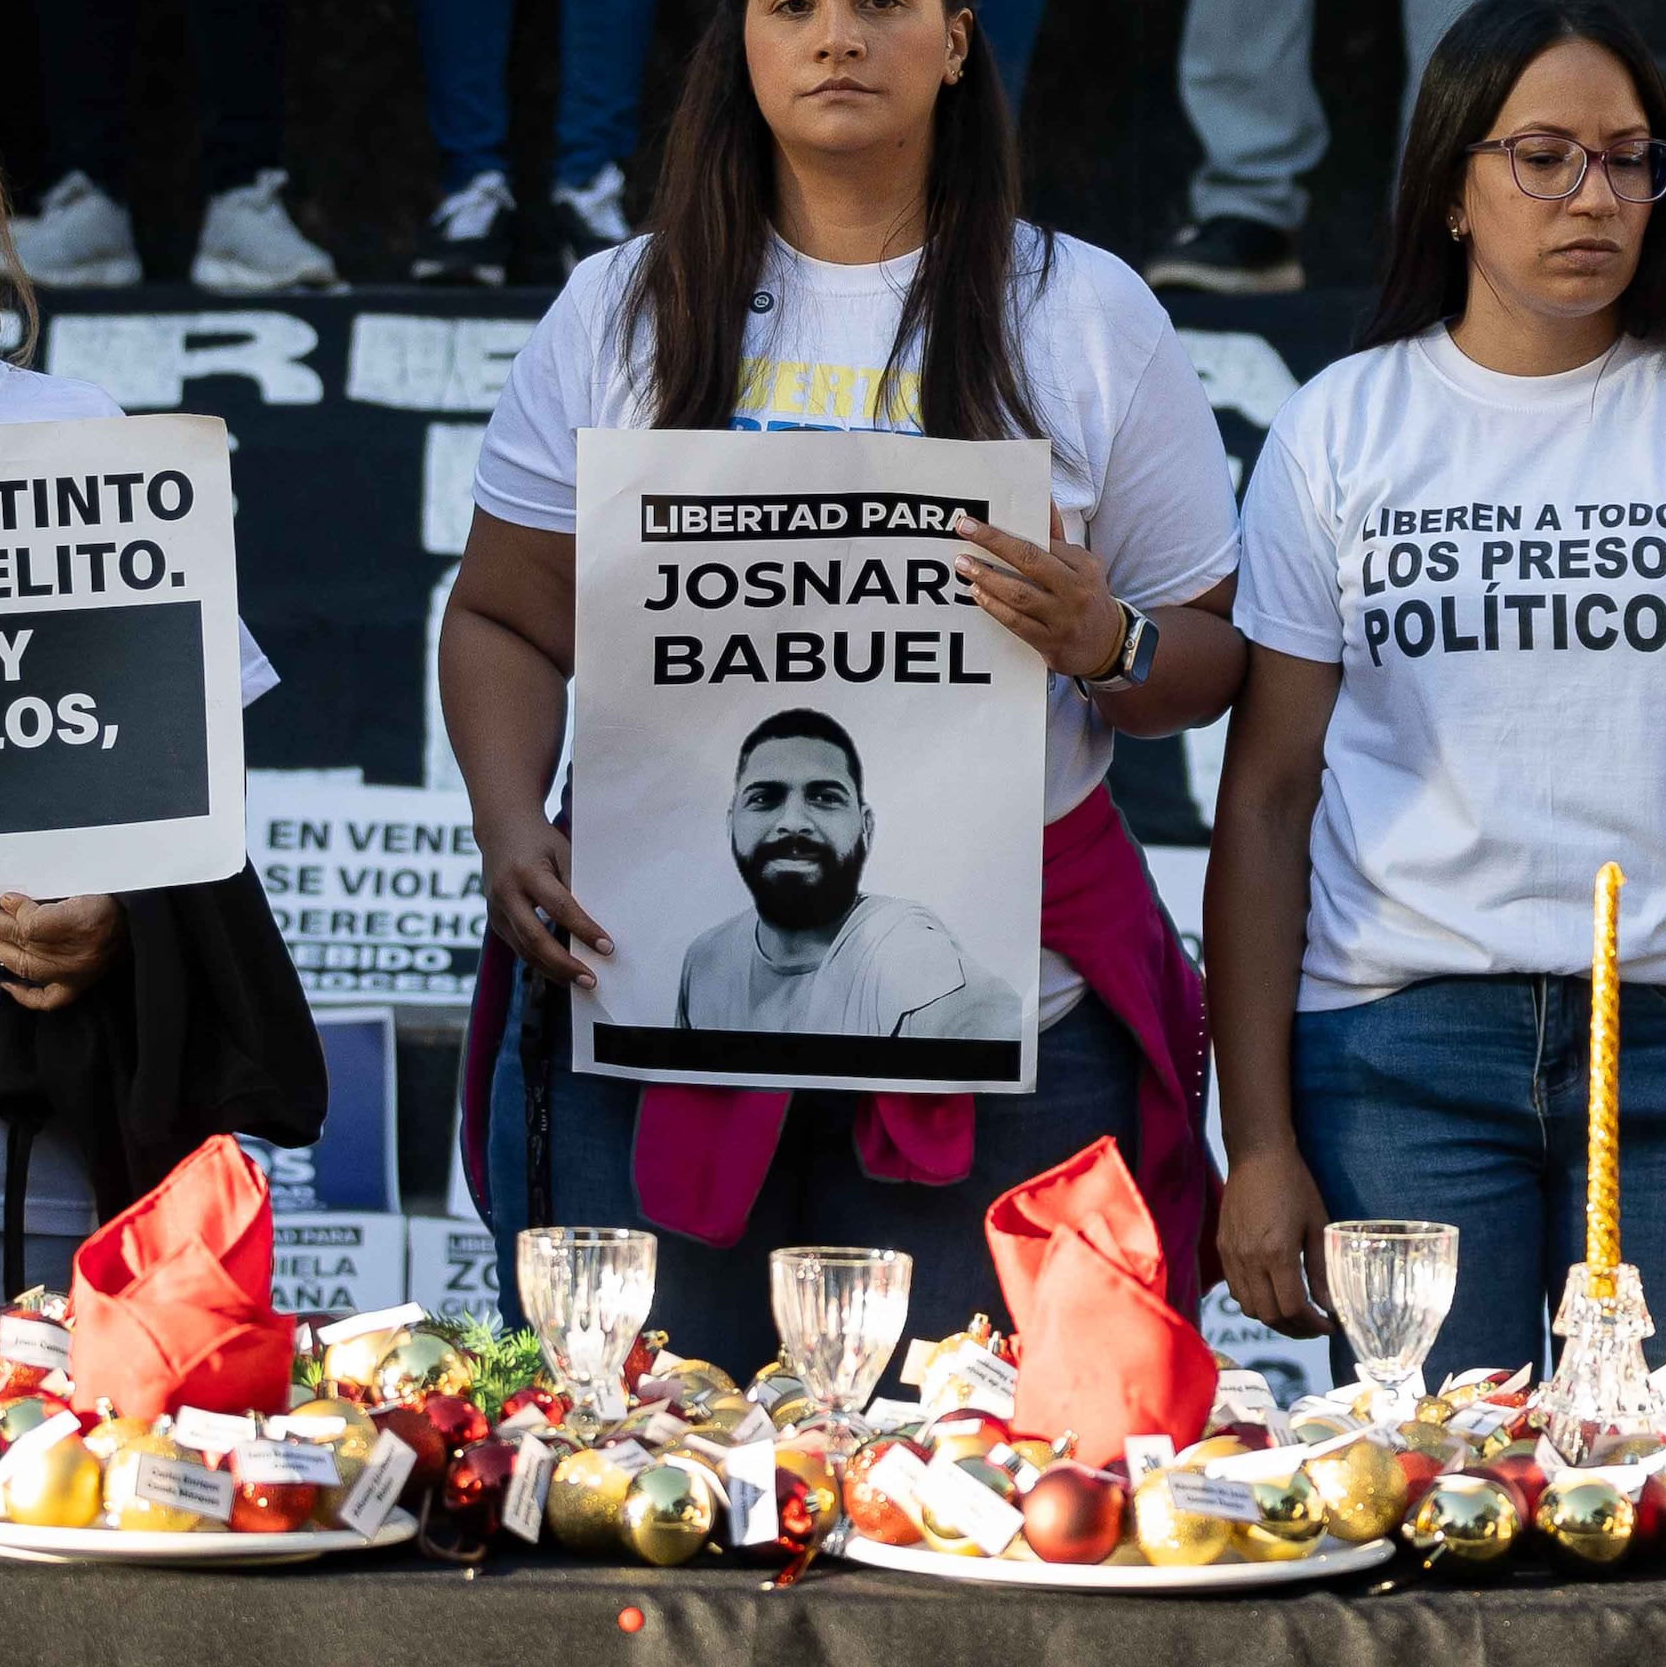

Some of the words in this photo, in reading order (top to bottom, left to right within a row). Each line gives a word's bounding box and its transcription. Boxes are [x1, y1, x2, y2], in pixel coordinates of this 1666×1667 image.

[644, 503, 848, 535] LIBERTAD
[862, 502, 970, 534] PARA
[1362, 502, 1522, 542] LIBEREN
[1535, 503, 1562, 531] A
[1362, 541, 1459, 597] LOS
[653, 631, 993, 686] BABUEL
[267, 818, 330, 852] EN
[347, 821, 480, 856] VENE
[264, 864, 324, 895] SE
[272, 909, 487, 938] DERECHO
